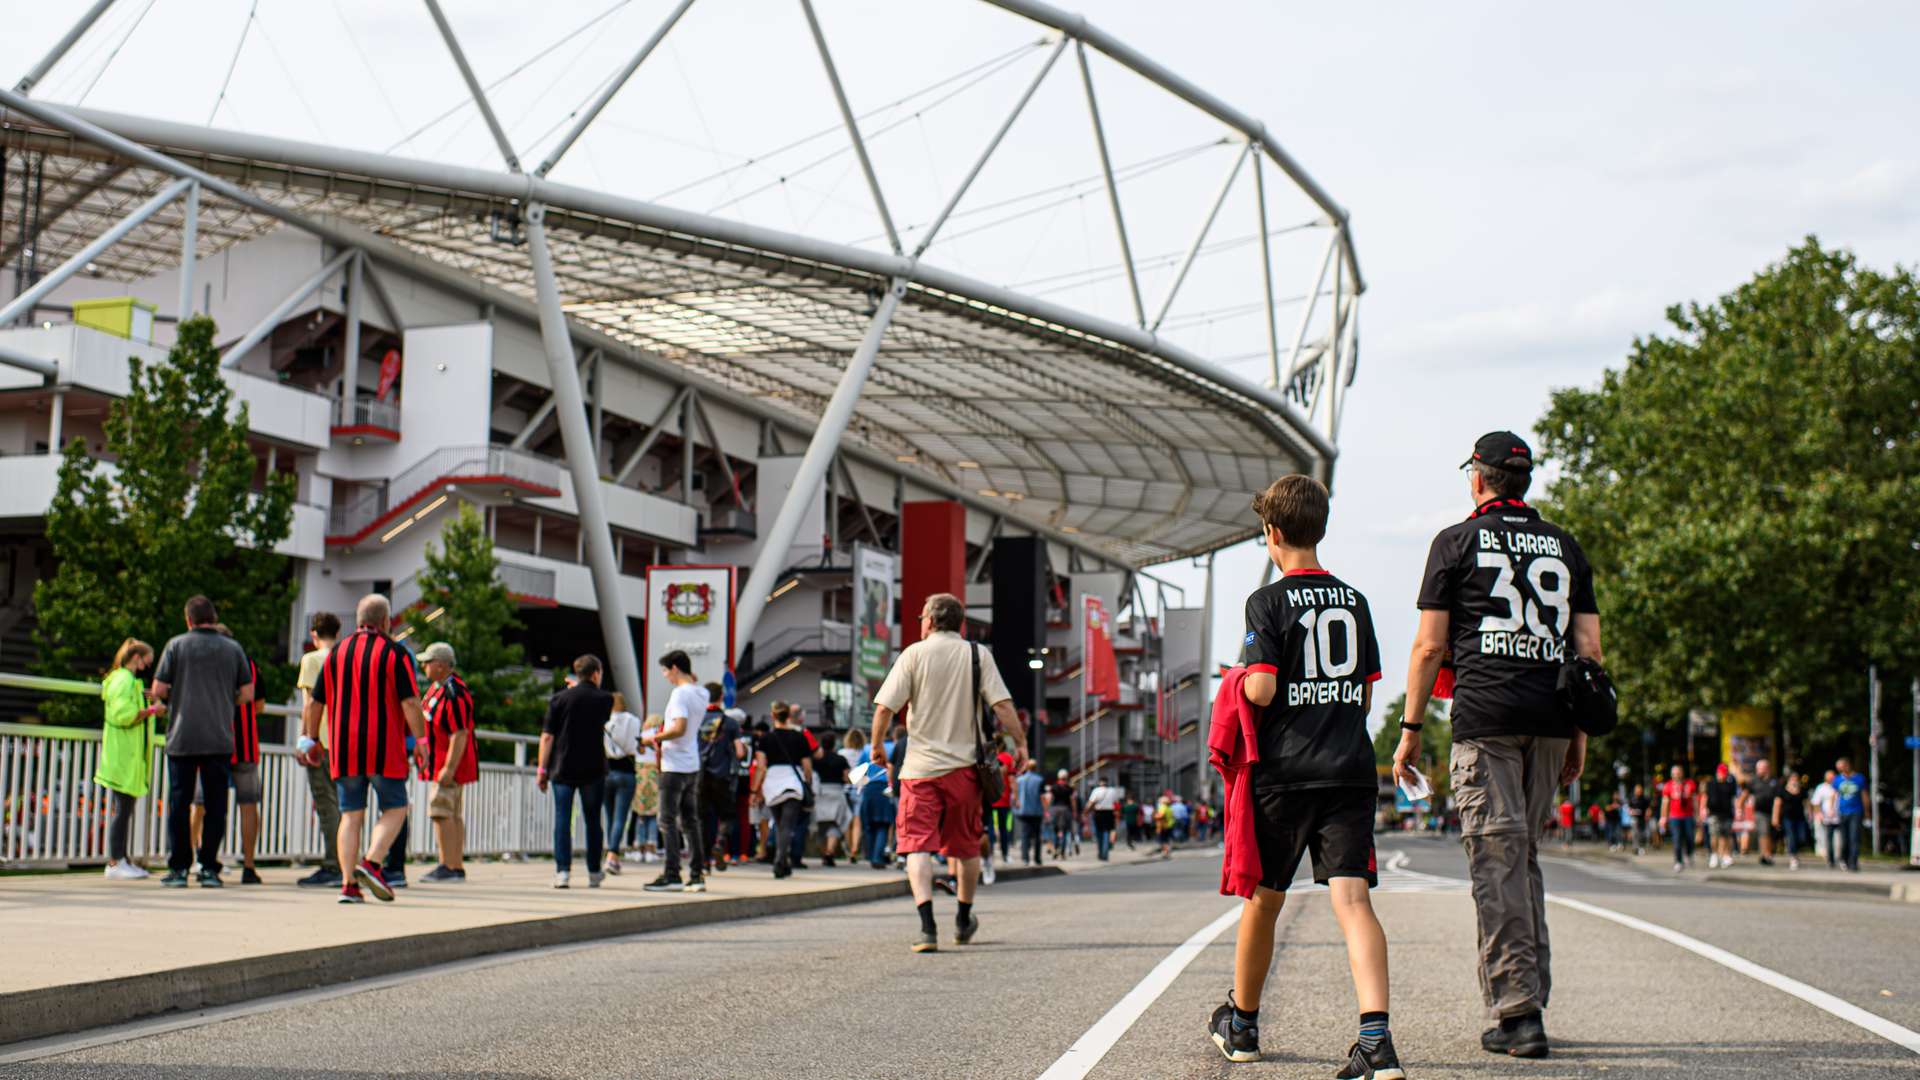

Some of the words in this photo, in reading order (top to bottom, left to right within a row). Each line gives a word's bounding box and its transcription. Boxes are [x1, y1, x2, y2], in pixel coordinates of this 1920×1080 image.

[1479, 528, 1562, 557] BELARABI
[1286, 587, 1356, 607] MATHIS
[1299, 607, 1358, 679] 10
[1481, 631, 1540, 660] BAYER
[1542, 638, 1566, 664] 04
[1288, 680, 1339, 706] BAYER
[1342, 680, 1363, 706] 04
